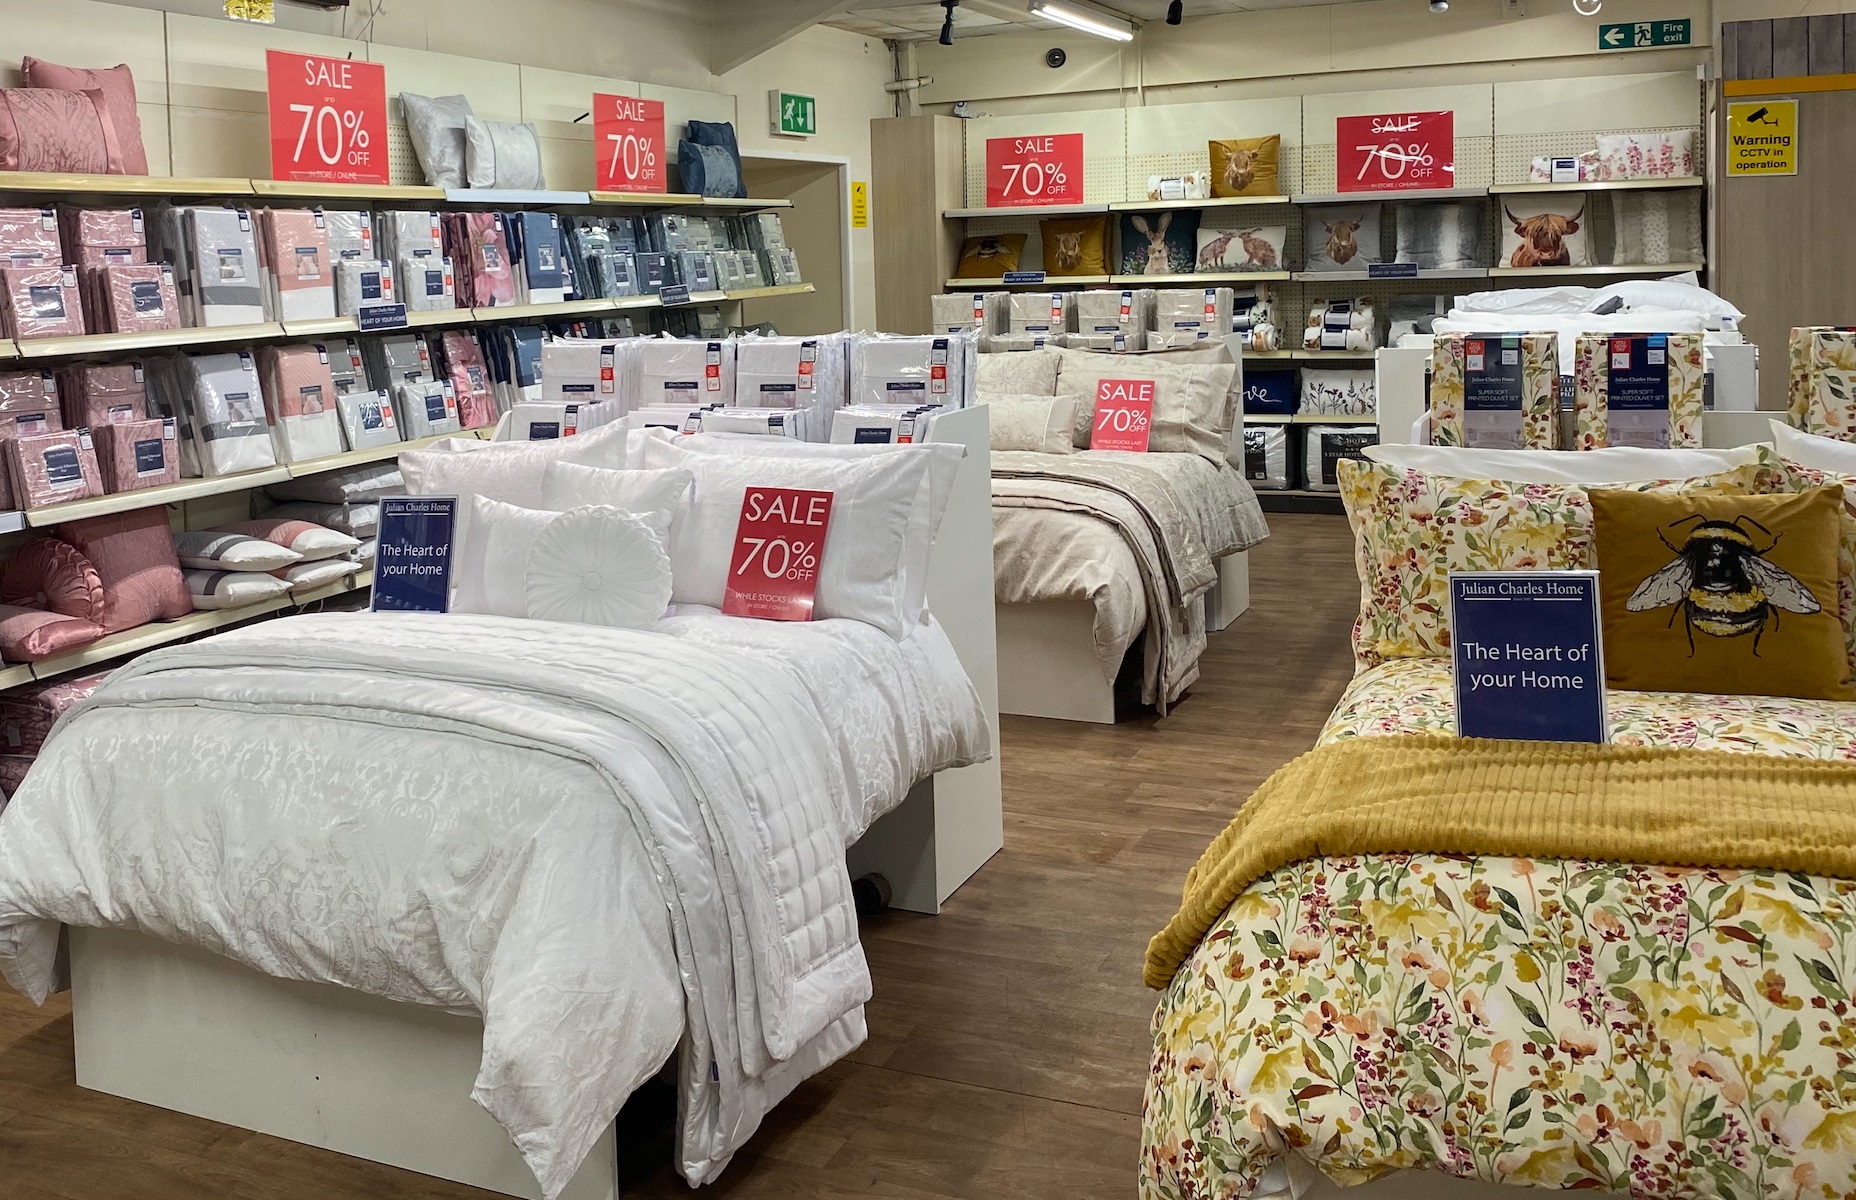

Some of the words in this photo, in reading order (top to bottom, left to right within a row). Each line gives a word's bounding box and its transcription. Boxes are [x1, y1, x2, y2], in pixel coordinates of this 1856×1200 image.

[1663, 24, 1684, 32] Fire
[1664, 33, 1683, 42] exit
[305, 59, 352, 89] SALE
[616, 100, 645, 122] SALE
[1371, 116, 1418, 133] SALE
[290, 104, 370, 165] 70%
[1733, 135, 1790, 146] Warning
[1015, 138, 1054, 154] SALE
[1740, 149, 1770, 157] CCTV
[348, 151, 370, 165] OFF
[607, 134, 655, 180] 70%
[1356, 143, 1433, 181] 70%
[1736, 160, 1787, 170] operation
[642, 169, 655, 180] OFF
[1002, 162, 1066, 197] 70%
[1410, 168, 1433, 178] OFF
[1047, 186, 1066, 195] OFF
[1100, 383, 1151, 401] SALE
[1098, 409, 1147, 432] 70%
[385, 503, 404, 513] Julian
[406, 503, 429, 511] Charles
[745, 493, 827, 526] SALE
[382, 544, 401, 556] The
[404, 544, 433, 557] Heart
[436, 544, 448, 556] of
[737, 538, 816, 579] 70%
[382, 565, 407, 577] your
[410, 564, 442, 575] Home
[786, 568, 814, 581] OFF
[1460, 582, 1496, 597] Julian
[1498, 582, 1543, 594] Charles
[1547, 582, 1584, 594] Home
[735, 592, 756, 600] WHILE
[758, 594, 786, 603] STOCKS
[788, 596, 806, 604] LAS
[1462, 642, 1500, 660] The
[1506, 643, 1562, 661] Heart
[1568, 643, 1589, 662] of
[1470, 674, 1516, 691] your
[1522, 671, 1584, 689] Home
